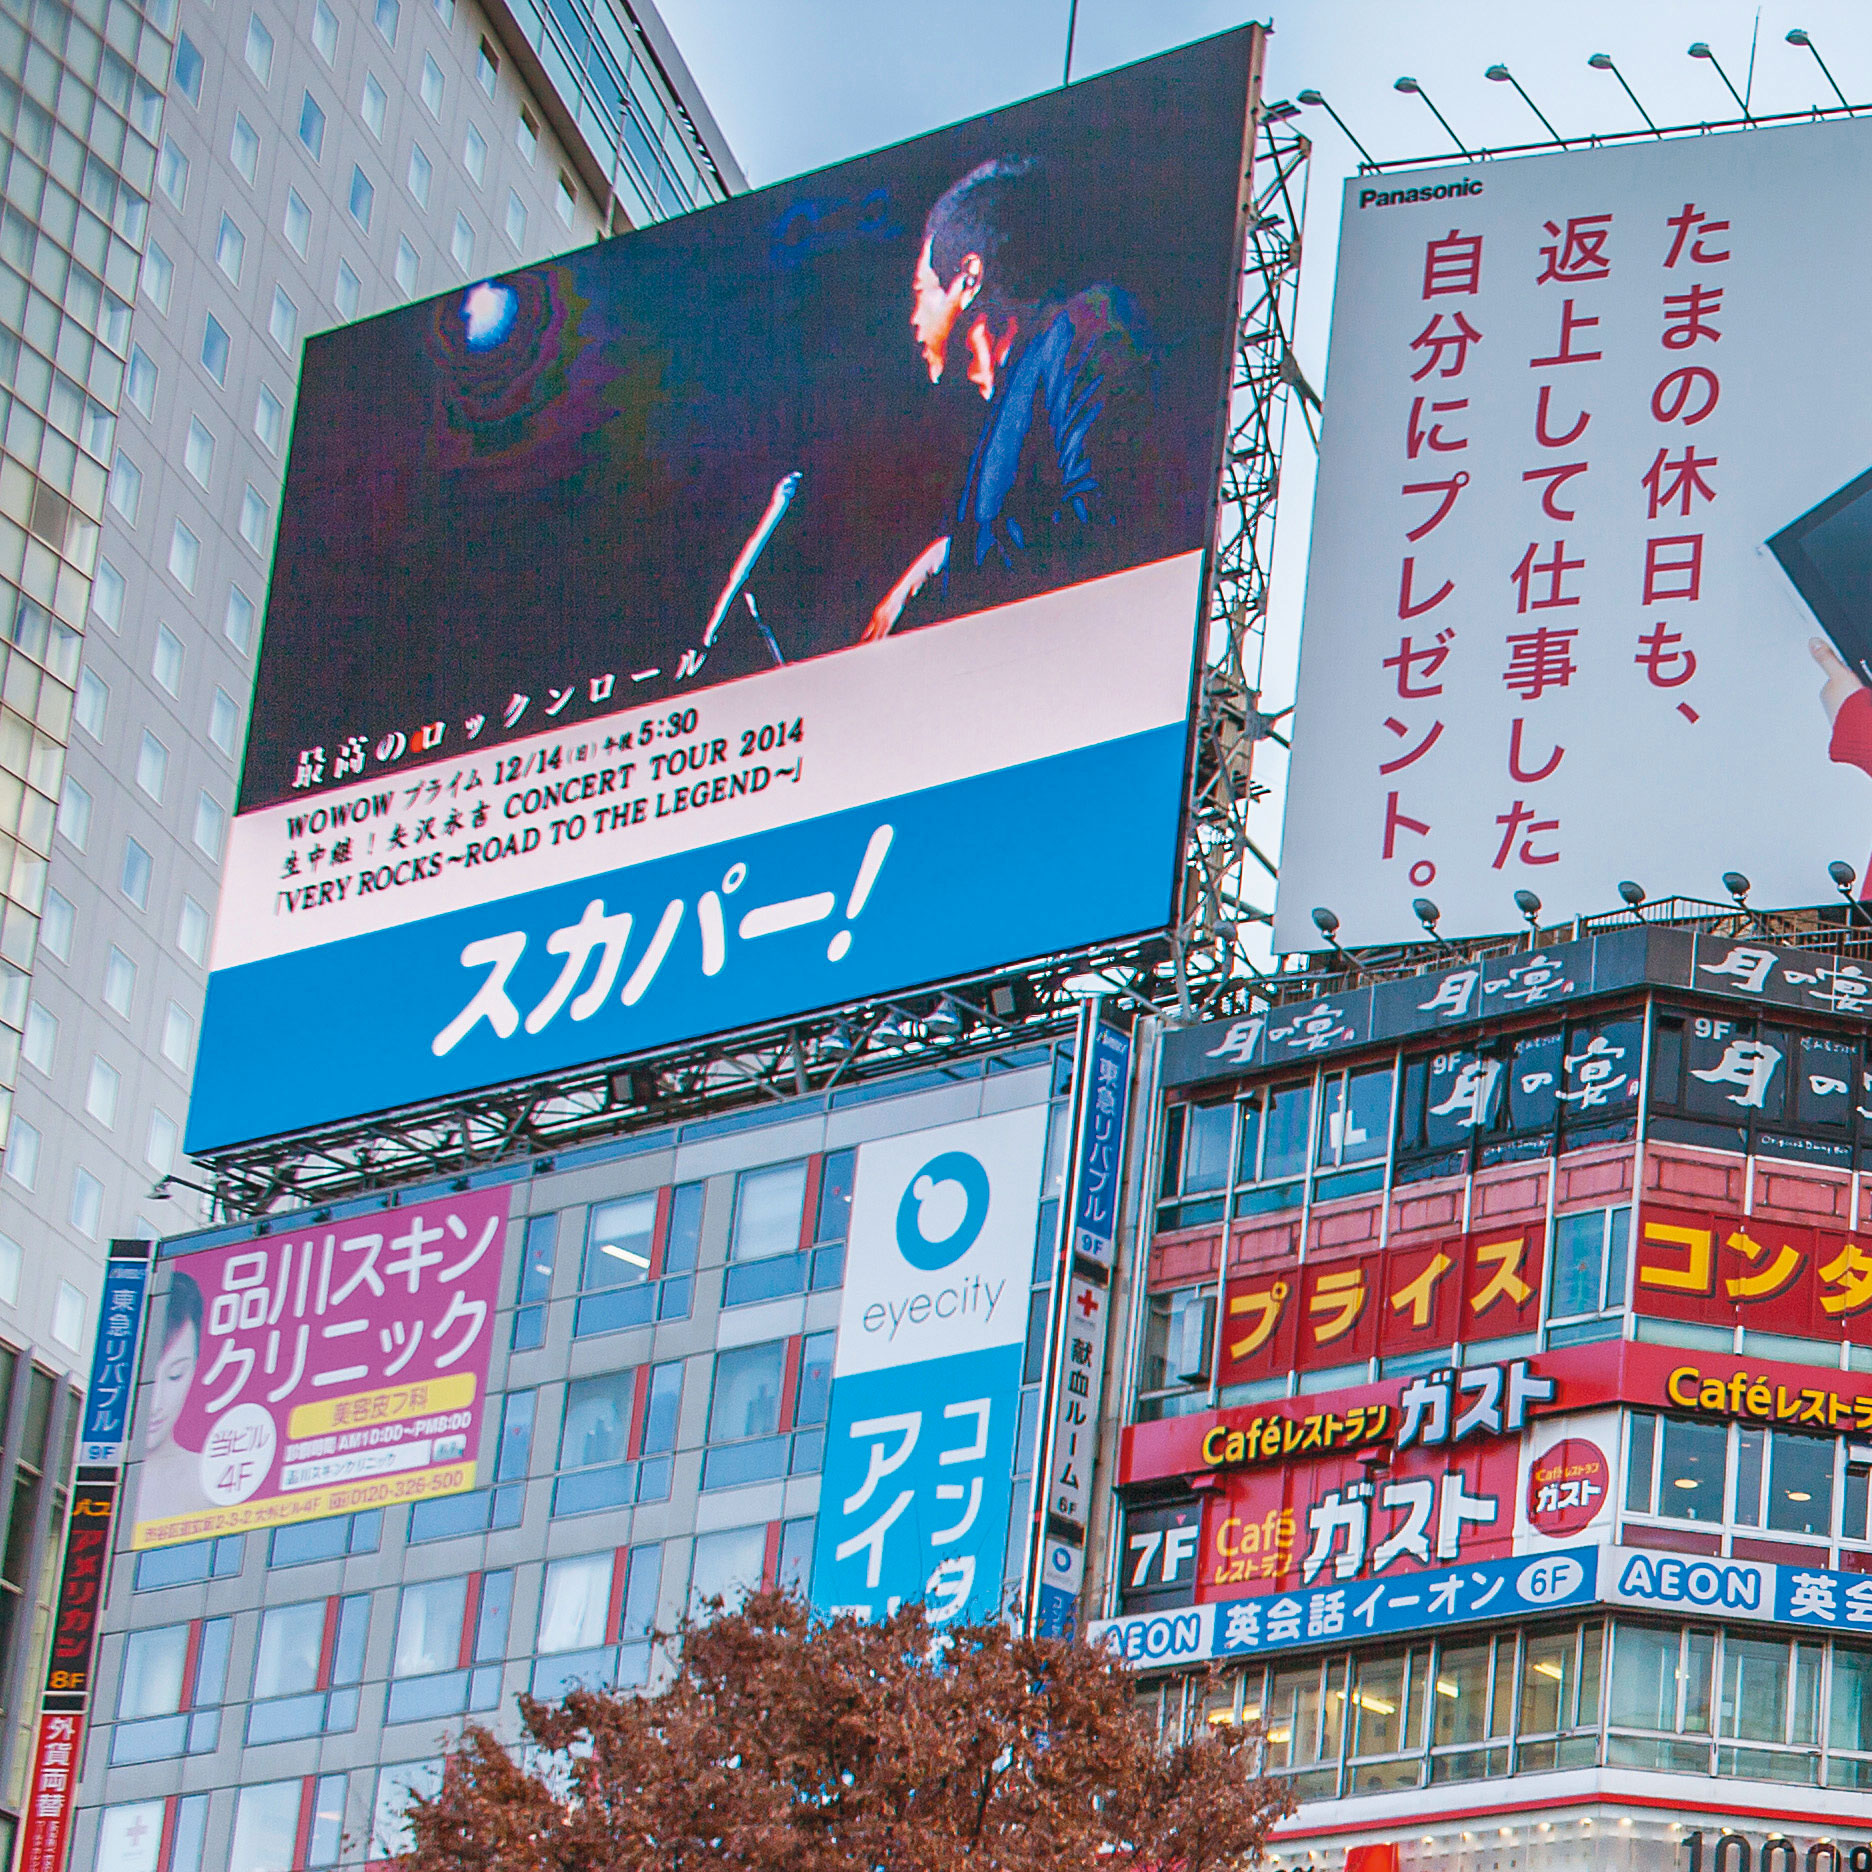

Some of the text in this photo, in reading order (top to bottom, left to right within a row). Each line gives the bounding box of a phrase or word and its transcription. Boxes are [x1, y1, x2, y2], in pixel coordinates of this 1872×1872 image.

[1358, 175, 1485, 211] Panasonic
[1632, 201, 1733, 726] たまの休日も、
[1381, 227, 1485, 890] 自分にプレゼント。
[1493, 211, 1614, 872] 返上して仕事した
[290, 647, 706, 790] 最高のロックンロール
[502, 718, 804, 818] CONCERT TOUR 2014
[286, 770, 484, 840] WOWOW プライム
[550, 802, 648, 854] TO THE
[433, 822, 896, 1056] スカパー!
[1416, 955, 1562, 1017] 月の宴
[1206, 1004, 1346, 1067] 月の宴
[1694, 1018, 1730, 1040] 9F
[1432, 1054, 1461, 1075] 9F
[1083, 1055, 1119, 1222] 東急リバブル
[209, 1214, 500, 1336] 品川スキン
[1080, 1234, 1104, 1256] 9F
[861, 1272, 1008, 1343] eyecity
[1228, 1237, 1535, 1360] プライス
[90, 1288, 139, 1434] 東急リバブル
[201, 1290, 488, 1414] クリニック
[209, 1423, 271, 1460] 当ビル
[1057, 1337, 1094, 1492] 献血ルーム
[1201, 1360, 1555, 1468] Caféレストラン ガスト
[88, 1444, 115, 1460] 9F
[216, 1461, 254, 1494] 4F
[1057, 1495, 1079, 1516] 6F
[1304, 1468, 1498, 1584] ガスト
[1535, 1479, 1602, 1513] ガスト
[1131, 1526, 1197, 1586] 7F
[1215, 1509, 1297, 1558] Café
[1215, 1552, 1293, 1585] レストラン
[54, 1529, 102, 1659] アメリカン
[1105, 1612, 1201, 1660] AEON
[1224, 1572, 1505, 1648] 英会話イーオン
[1527, 1563, 1569, 1597] 6F
[1620, 1553, 1761, 1610] AEON
[49, 1670, 86, 1690] 8F
[34, 1717, 76, 1818] 外貨両替
